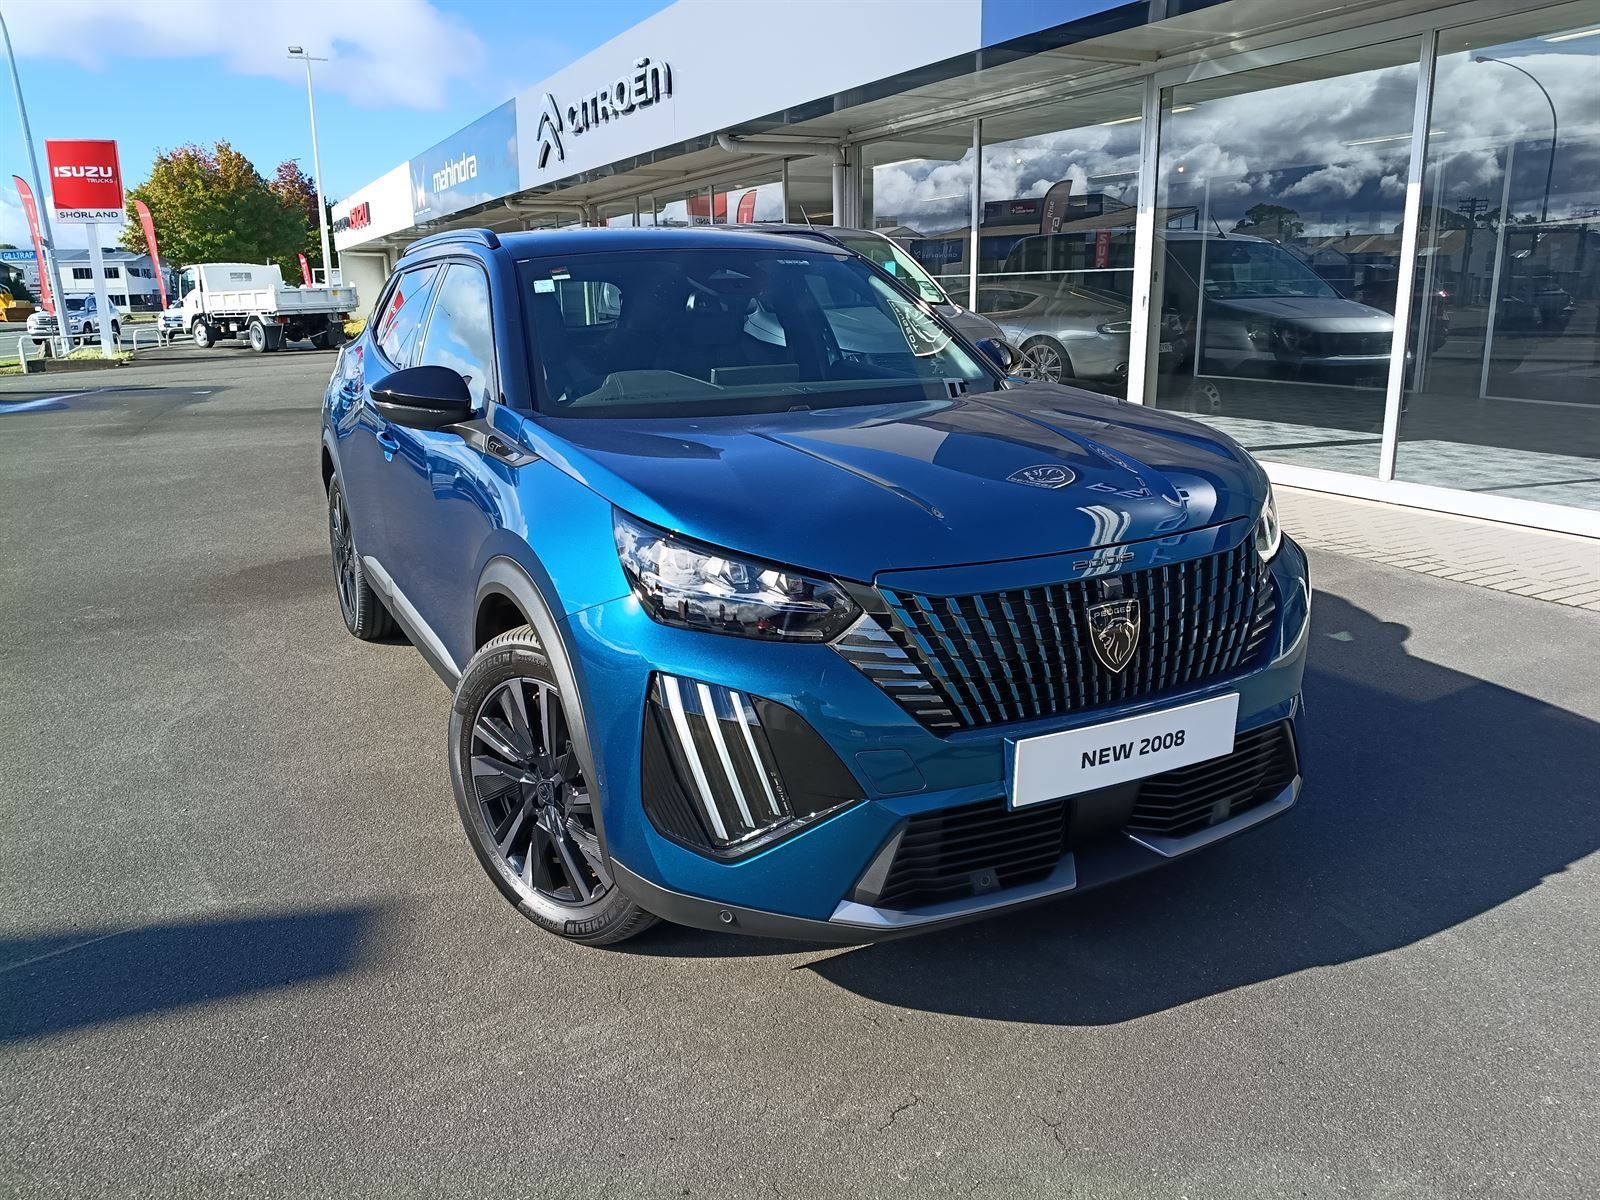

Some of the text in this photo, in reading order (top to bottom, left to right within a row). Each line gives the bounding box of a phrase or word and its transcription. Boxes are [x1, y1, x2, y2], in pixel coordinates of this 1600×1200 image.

[54, 166, 113, 178] ISUZU
[432, 152, 478, 193] mahindra
[60, 211, 119, 219] SHORLAND
[3, 251, 34, 261] GILLTRAP
[1073, 551, 1135, 571] 2008
[1093, 605, 1136, 619] PEUGEOT
[1081, 729, 1185, 769] NEW 2008
